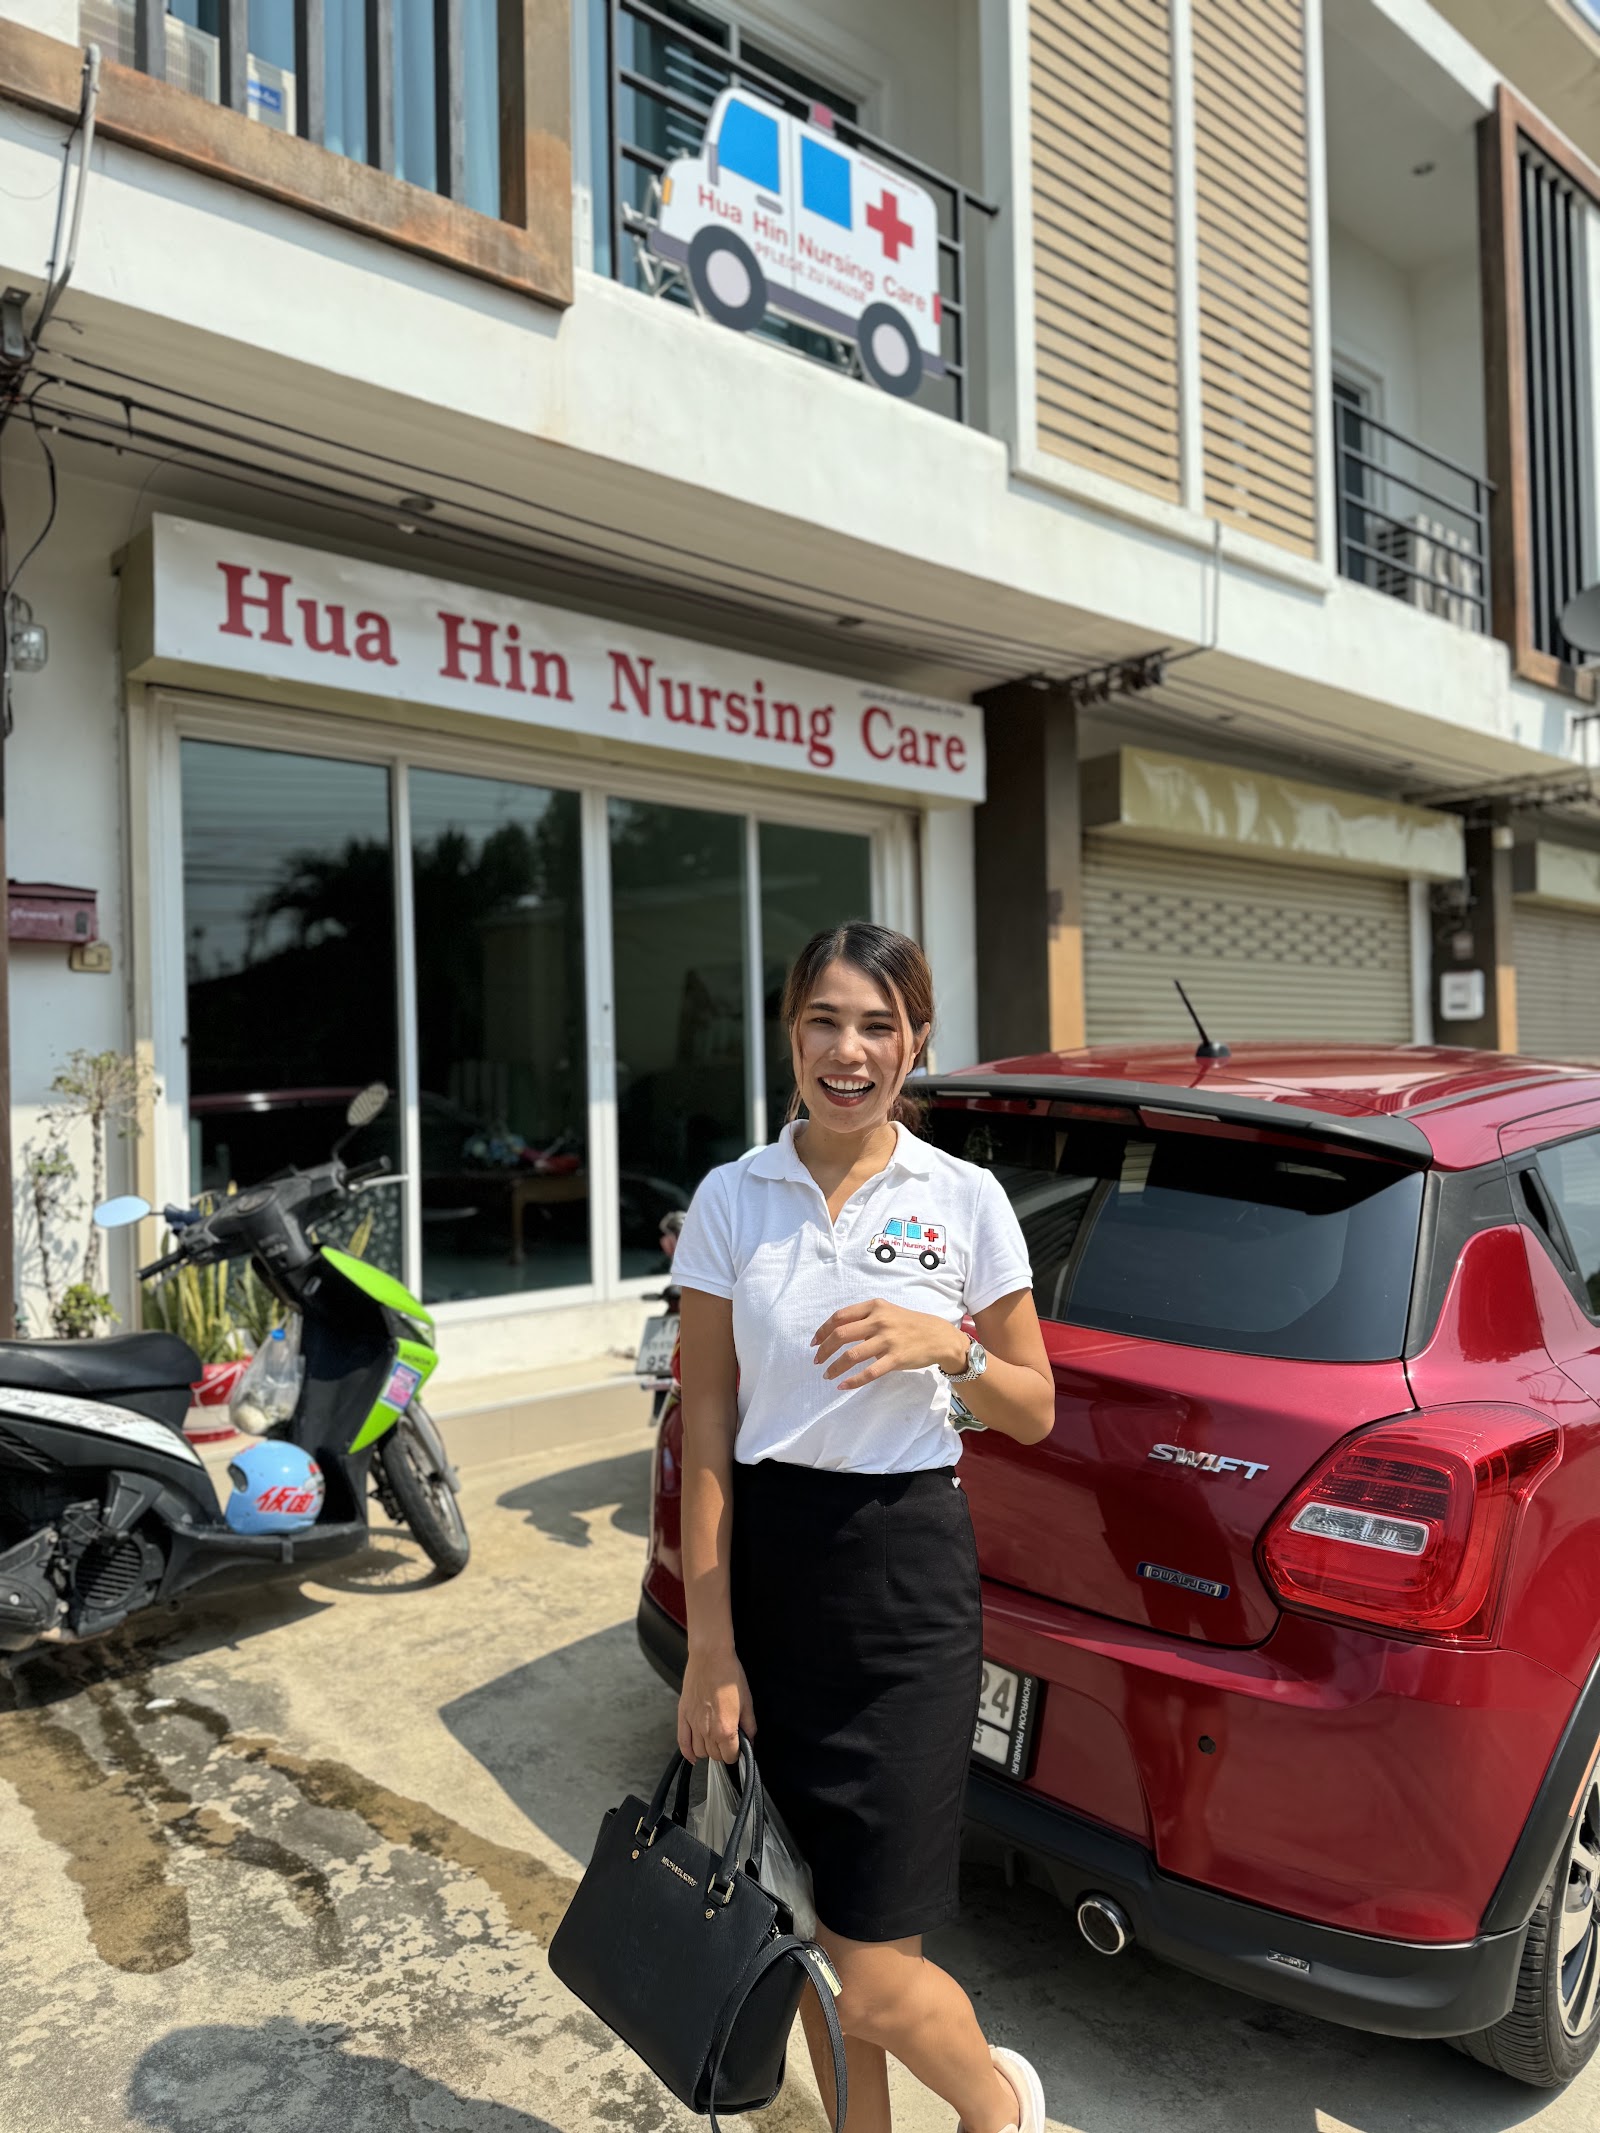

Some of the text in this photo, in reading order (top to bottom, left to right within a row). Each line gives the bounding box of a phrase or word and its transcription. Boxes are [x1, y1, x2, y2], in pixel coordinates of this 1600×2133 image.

[698, 183, 926, 313] Hua Hin Nursing Care
[216, 561, 967, 772] Hua Hin Nursing Care
[878, 1237, 889, 1245] Hua
[903, 1241, 926, 1250] Nursing
[928, 1244, 942, 1252] Care
[1147, 1443, 1270, 1480] SWIFT
[1011, 1677, 1032, 1775] SHOWROOM PRANBURI
